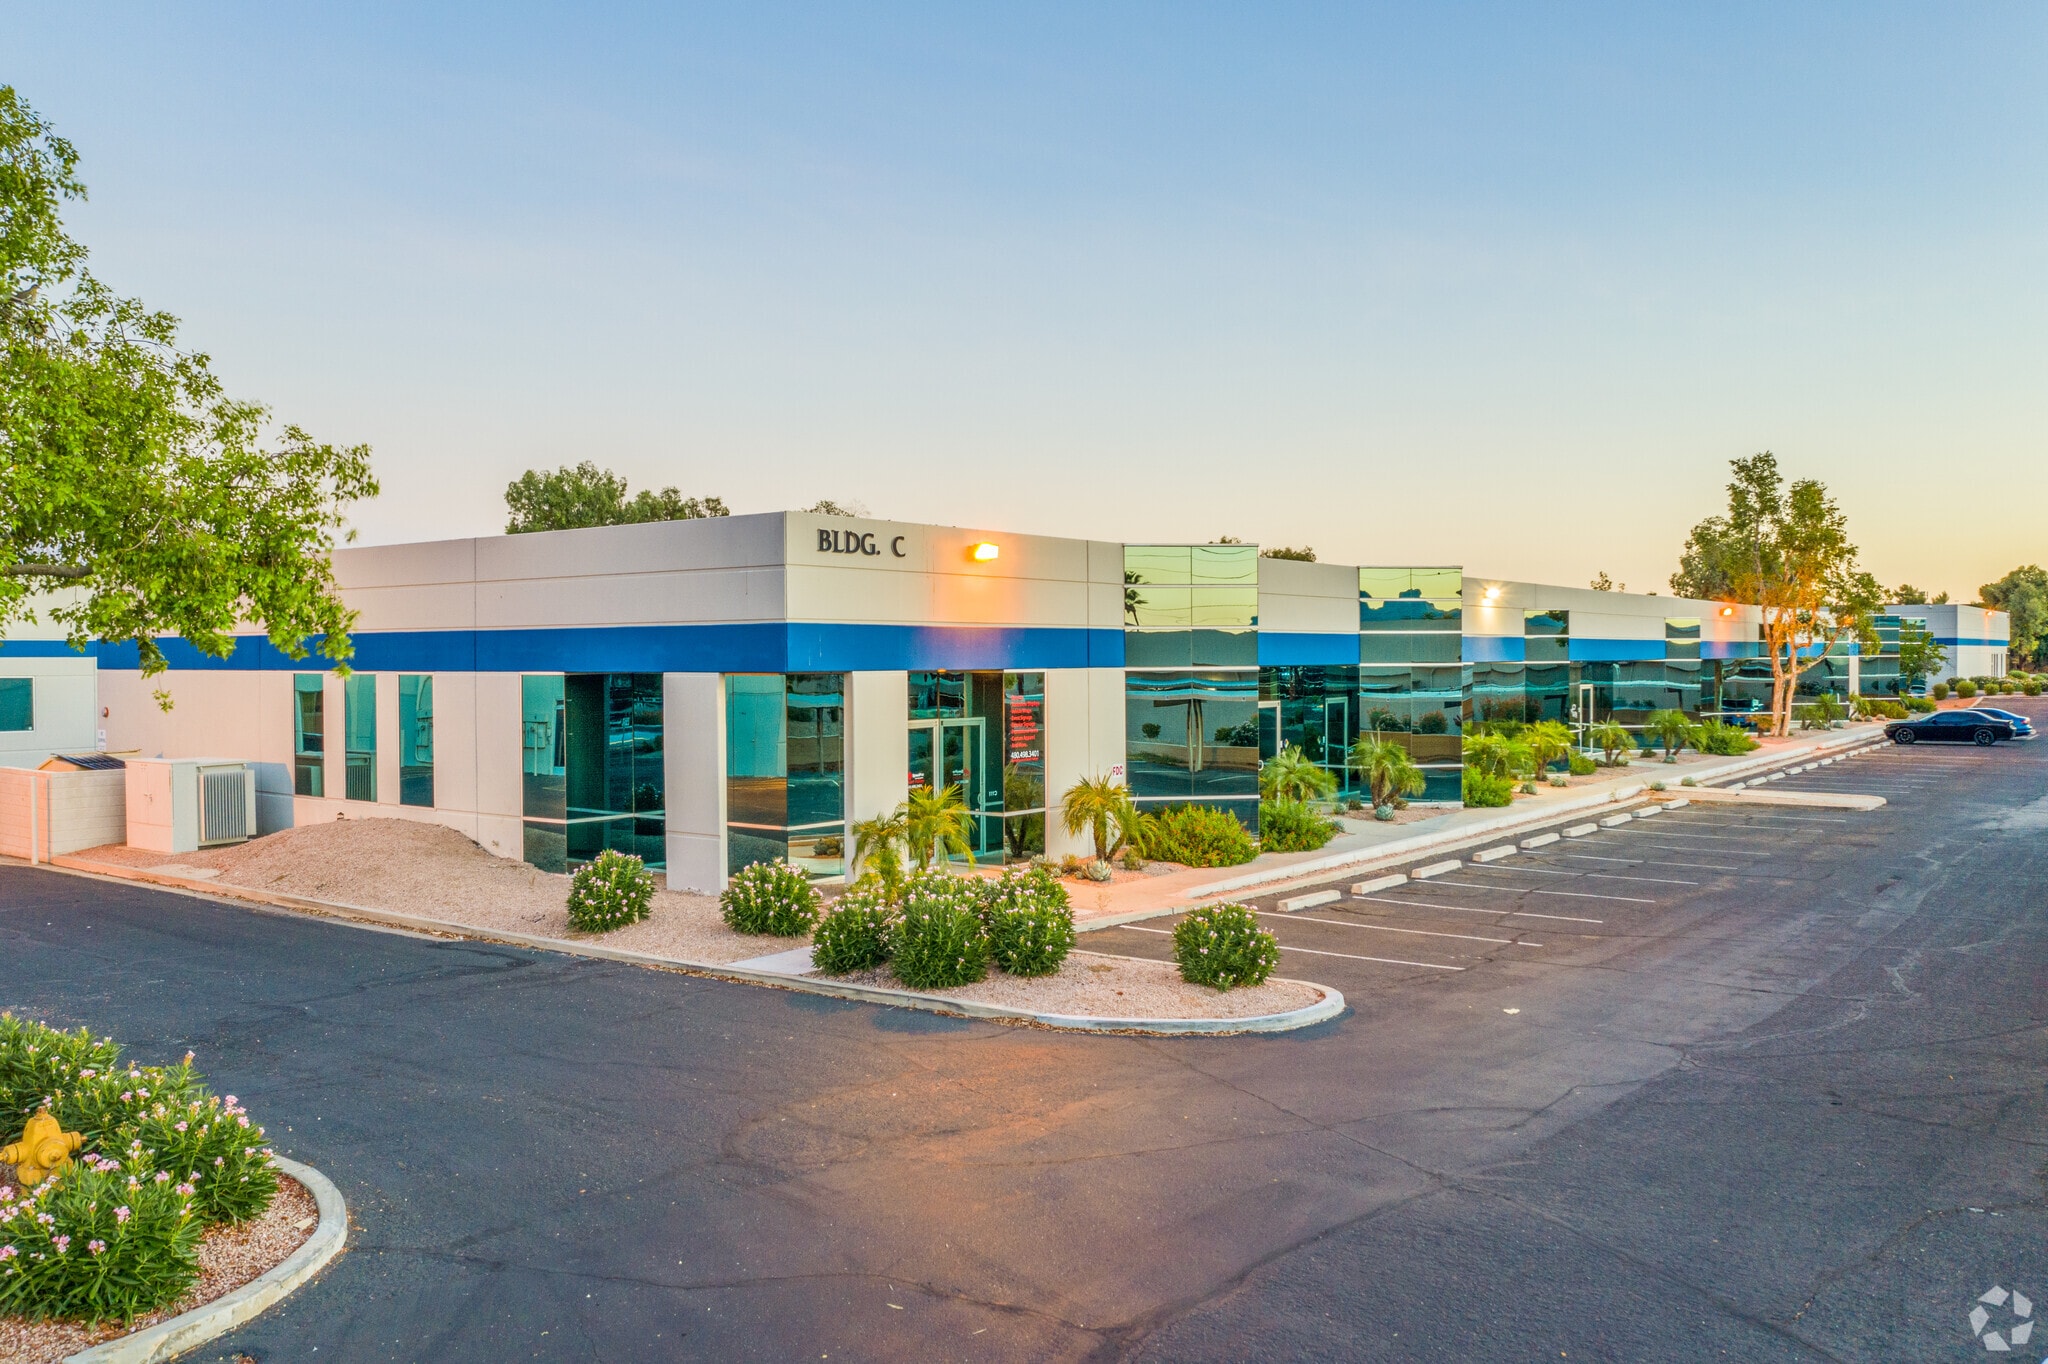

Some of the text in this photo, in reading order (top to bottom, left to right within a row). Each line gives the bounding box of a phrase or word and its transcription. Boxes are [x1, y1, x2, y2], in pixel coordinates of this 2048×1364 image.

[817, 528, 906, 558] BLDG. C
[1113, 765, 1123, 776] FDC
